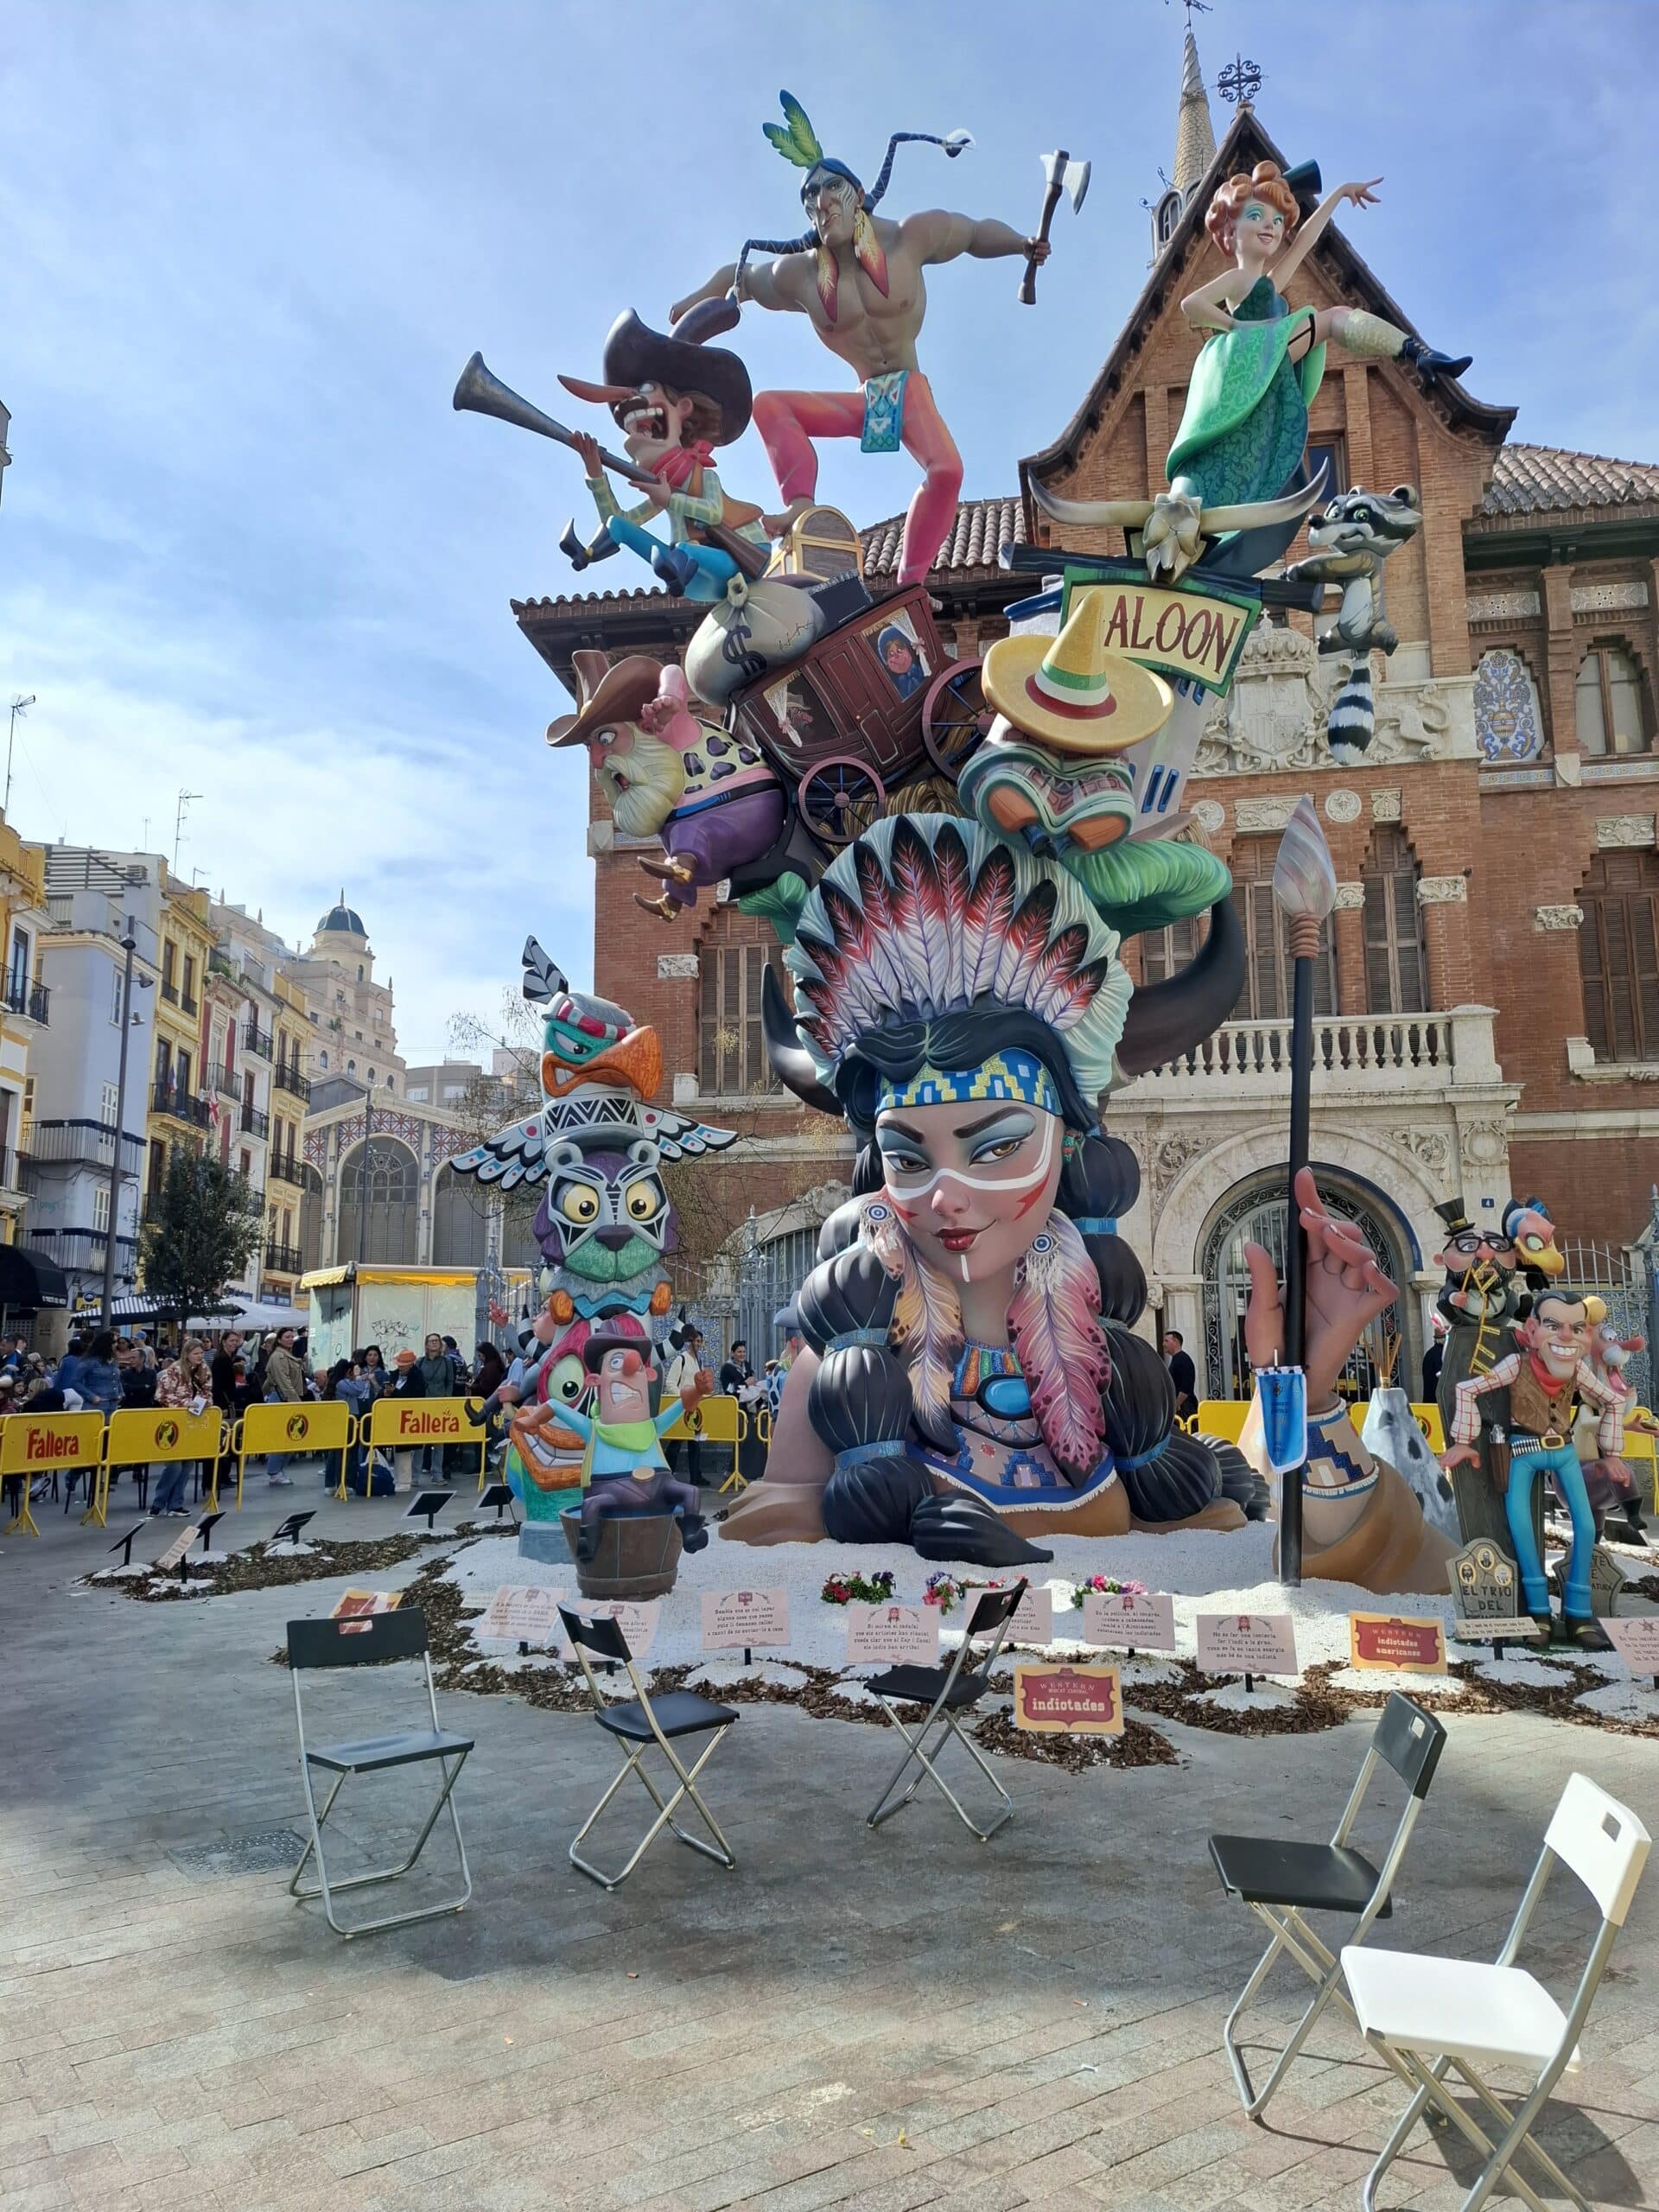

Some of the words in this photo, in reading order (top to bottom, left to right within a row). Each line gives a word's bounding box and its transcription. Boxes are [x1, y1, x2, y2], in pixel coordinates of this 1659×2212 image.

[1103, 594, 1240, 675] ALOON
[400, 1409, 460, 1434] Fallera
[27, 1428, 79, 1460] Fallera
[1463, 1586, 1478, 1597] EL
[1481, 1586, 1512, 1598] TRIO
[1592, 1583, 1612, 1592] ATURA
[1478, 1600, 1504, 1611] DEL
[1377, 1637, 1418, 1647] indiotades
[1376, 1648, 1421, 1656] americanes
[1039, 1681, 1096, 1691] WESTERN
[1033, 1697, 1105, 1713] indiotades
